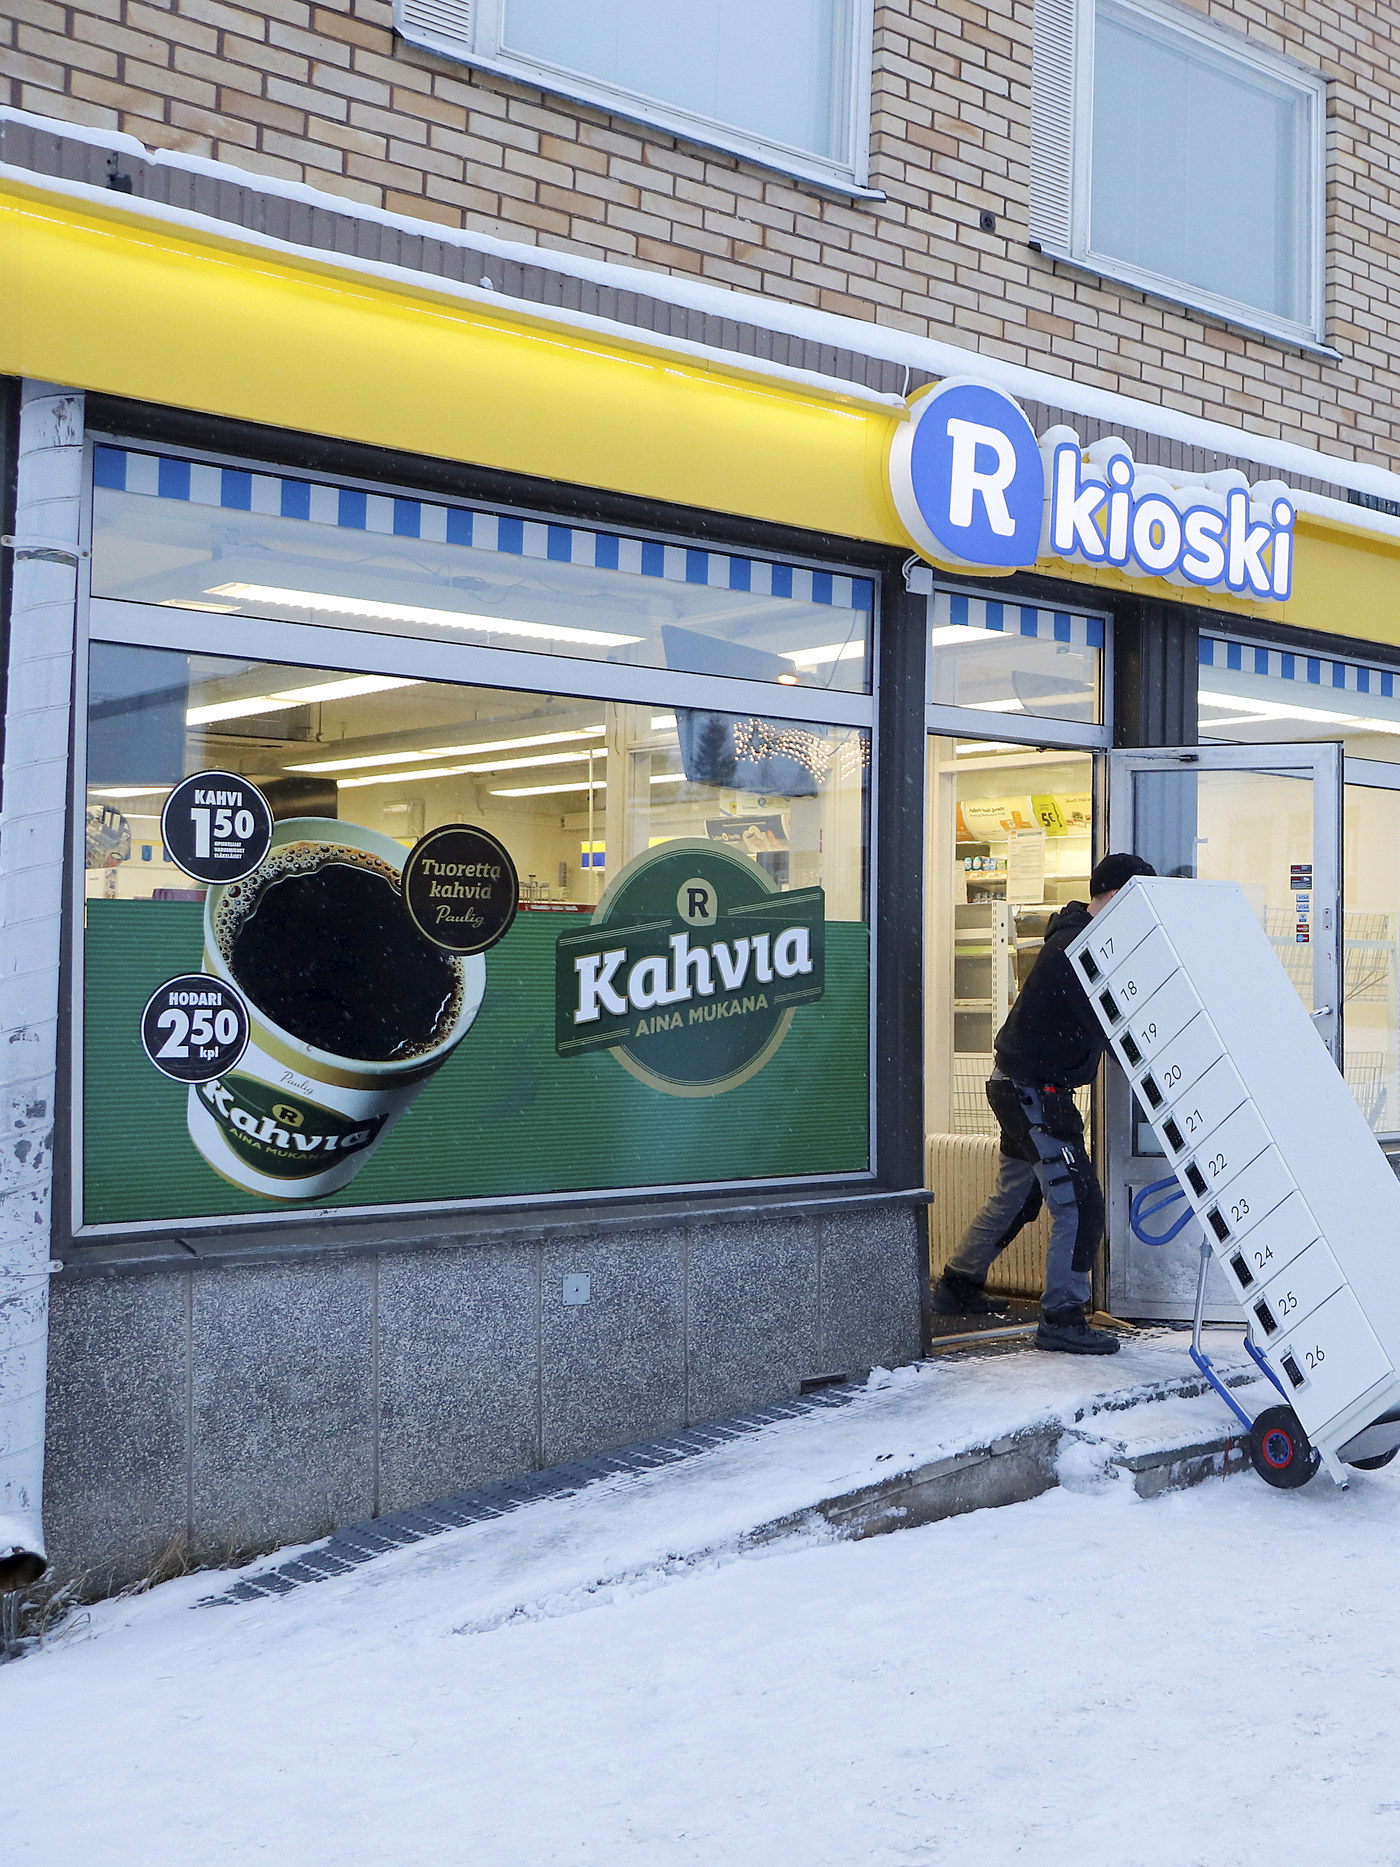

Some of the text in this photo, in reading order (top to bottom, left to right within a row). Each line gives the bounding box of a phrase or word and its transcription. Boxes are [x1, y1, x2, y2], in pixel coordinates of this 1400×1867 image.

[946, 417, 1292, 597] R kioski
[194, 789, 243, 806] KAHVI
[421, 859, 501, 878] Tuoretta
[429, 880, 492, 899] kahvia
[687, 887, 709, 918] R
[435, 904, 485, 928] Paulig
[1100, 937, 1115, 960] 17
[573, 925, 814, 1025] Kahvia
[168, 992, 222, 1006] HODARI
[1120, 980, 1138, 1001] 18
[635, 994, 769, 1037] AINA MUKANA
[1141, 1022, 1158, 1044] 19
[200, 1046, 219, 1060] kpl
[279, 1070, 314, 1095] Paulig
[1164, 1064, 1182, 1088] 20
[202, 1079, 371, 1152] Kahvia
[279, 1106, 298, 1124] R
[1185, 1109, 1204, 1132] 21
[229, 1127, 332, 1160] AINA MUKANA
[1208, 1153, 1228, 1178] 22
[1231, 1198, 1250, 1222] 23
[1254, 1244, 1274, 1269] 24
[1279, 1291, 1298, 1316] 25
[1305, 1345, 1325, 1370] 26
